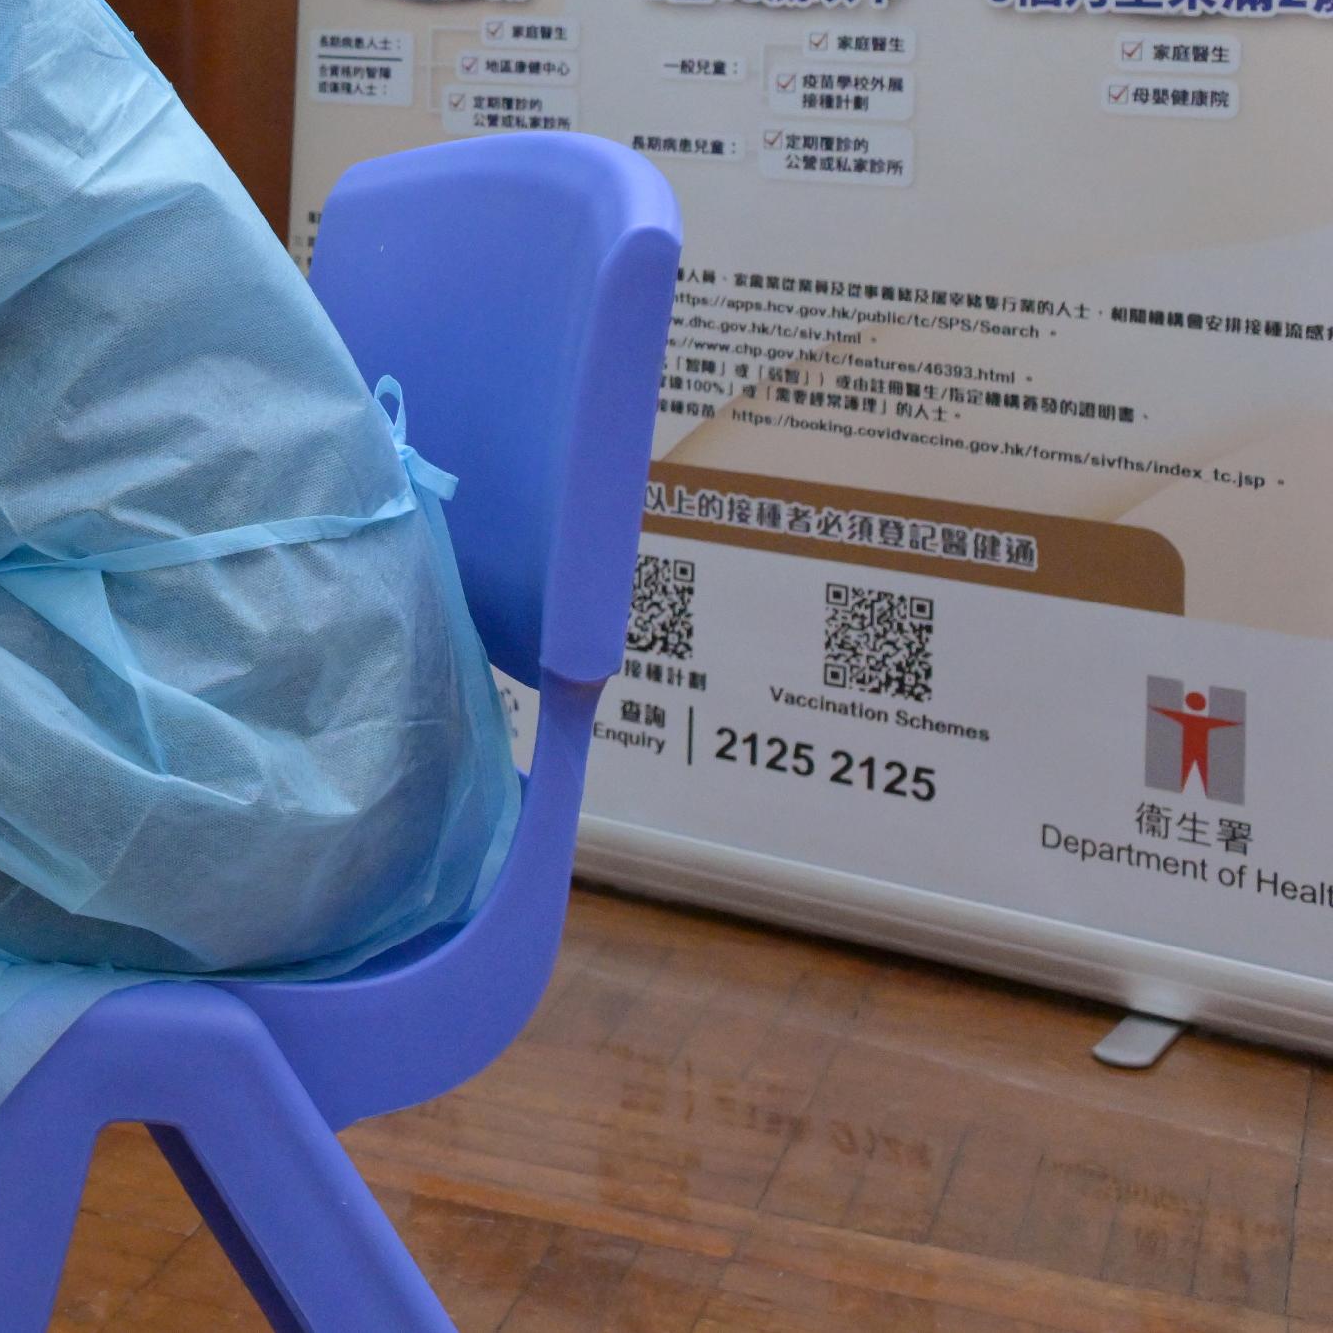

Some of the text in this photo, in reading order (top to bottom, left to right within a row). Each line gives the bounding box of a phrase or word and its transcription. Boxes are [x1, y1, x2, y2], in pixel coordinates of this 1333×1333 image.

[512, 25, 567, 41] 家庭醫生
[837, 35, 905, 53] 家庭醫生
[1153, 44, 1230, 64] 家庭醫生
[485, 59, 571, 77] 地區康健中心
[802, 74, 904, 93] 疫苗學校外展
[802, 93, 869, 112] 接種計劃
[1132, 87, 1230, 108] 母嬰健康院
[786, 134, 869, 153] 定期覆診的
[786, 154, 904, 176] 公營或私家診所
[644, 485, 1035, 567] 以上的接種者必須登記醫健通
[621, 699, 665, 728] 查詢
[770, 685, 990, 743] Vaccination Schemes
[593, 722, 665, 755] Enquiry
[715, 727, 936, 802] 2125 2125
[1041, 823, 1208, 882] Department
[1218, 864, 1247, 889] of
